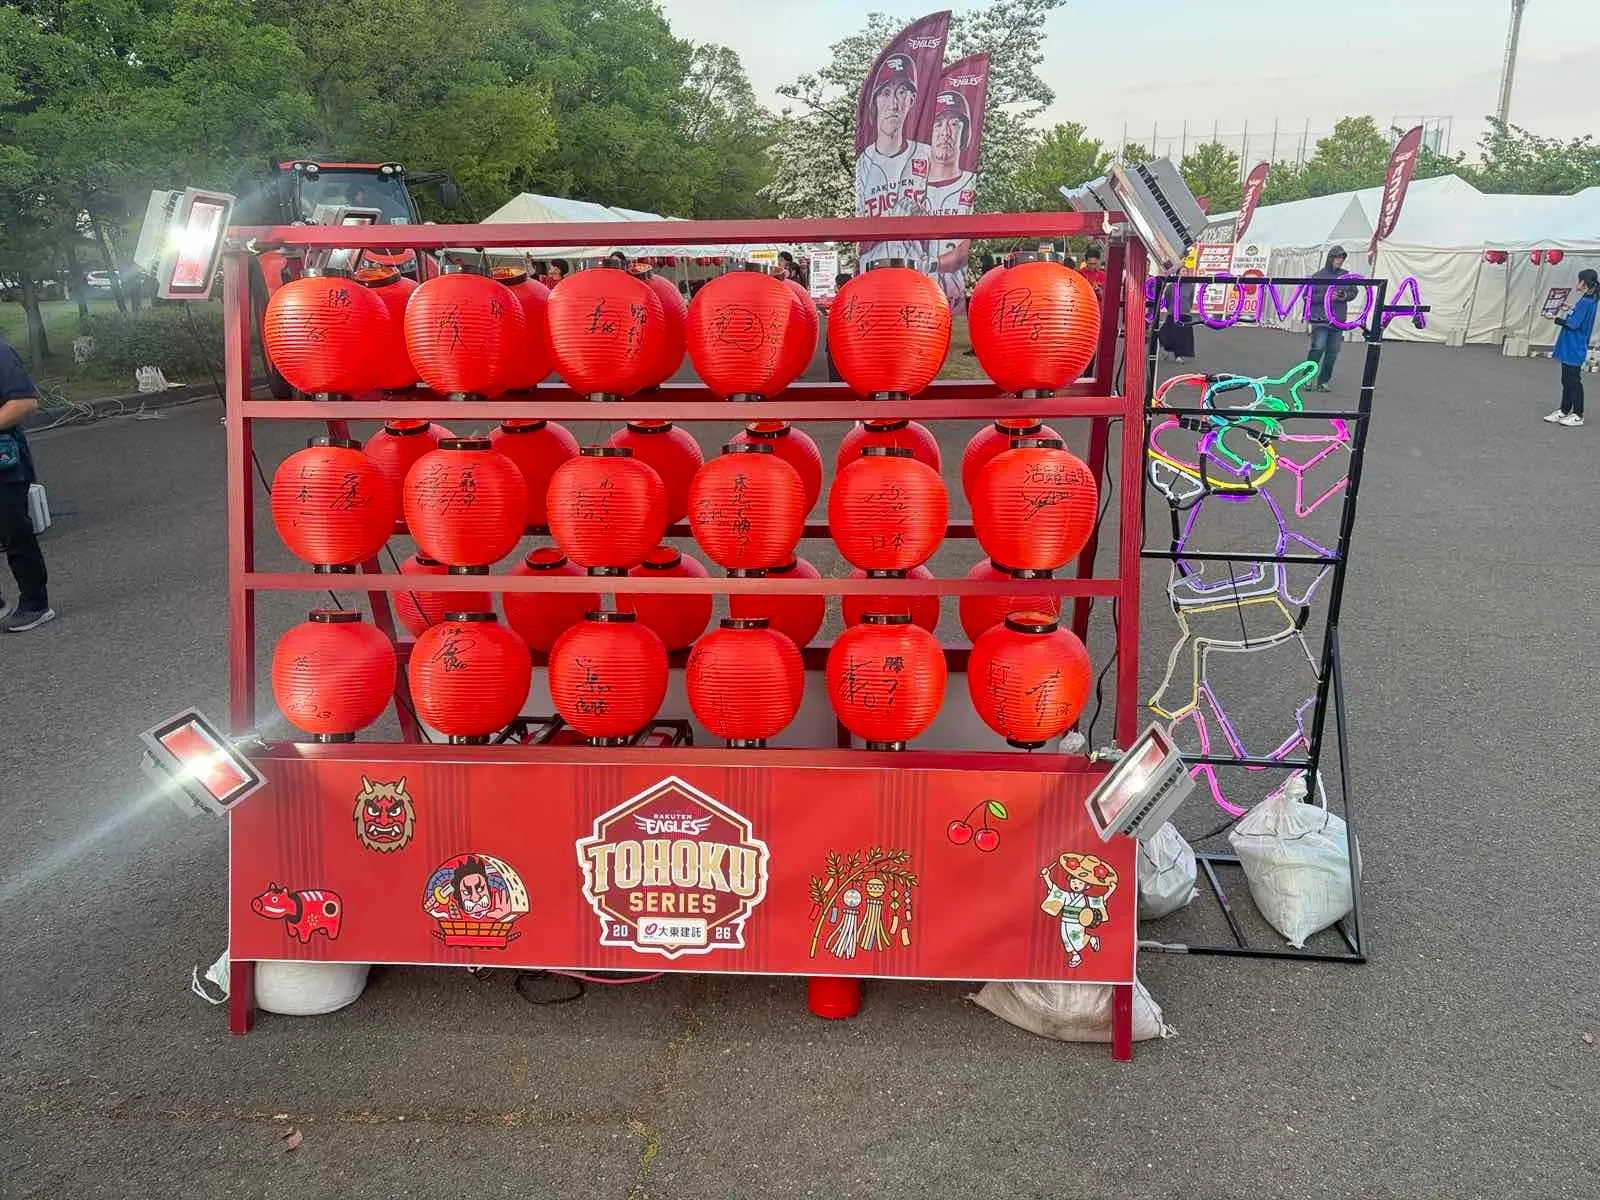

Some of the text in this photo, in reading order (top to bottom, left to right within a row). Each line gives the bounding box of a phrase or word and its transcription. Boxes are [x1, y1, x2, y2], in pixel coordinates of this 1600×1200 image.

[911, 38, 937, 49] EAGLES
[954, 76, 978, 87] EAGLES
[645, 819, 702, 835] EAGLES
[588, 840, 758, 896] TOHOKU
[630, 892, 715, 914] SERIES
[612, 925, 628, 937] 20
[658, 926, 702, 938] 大東建託
[715, 927, 731, 940] 26
